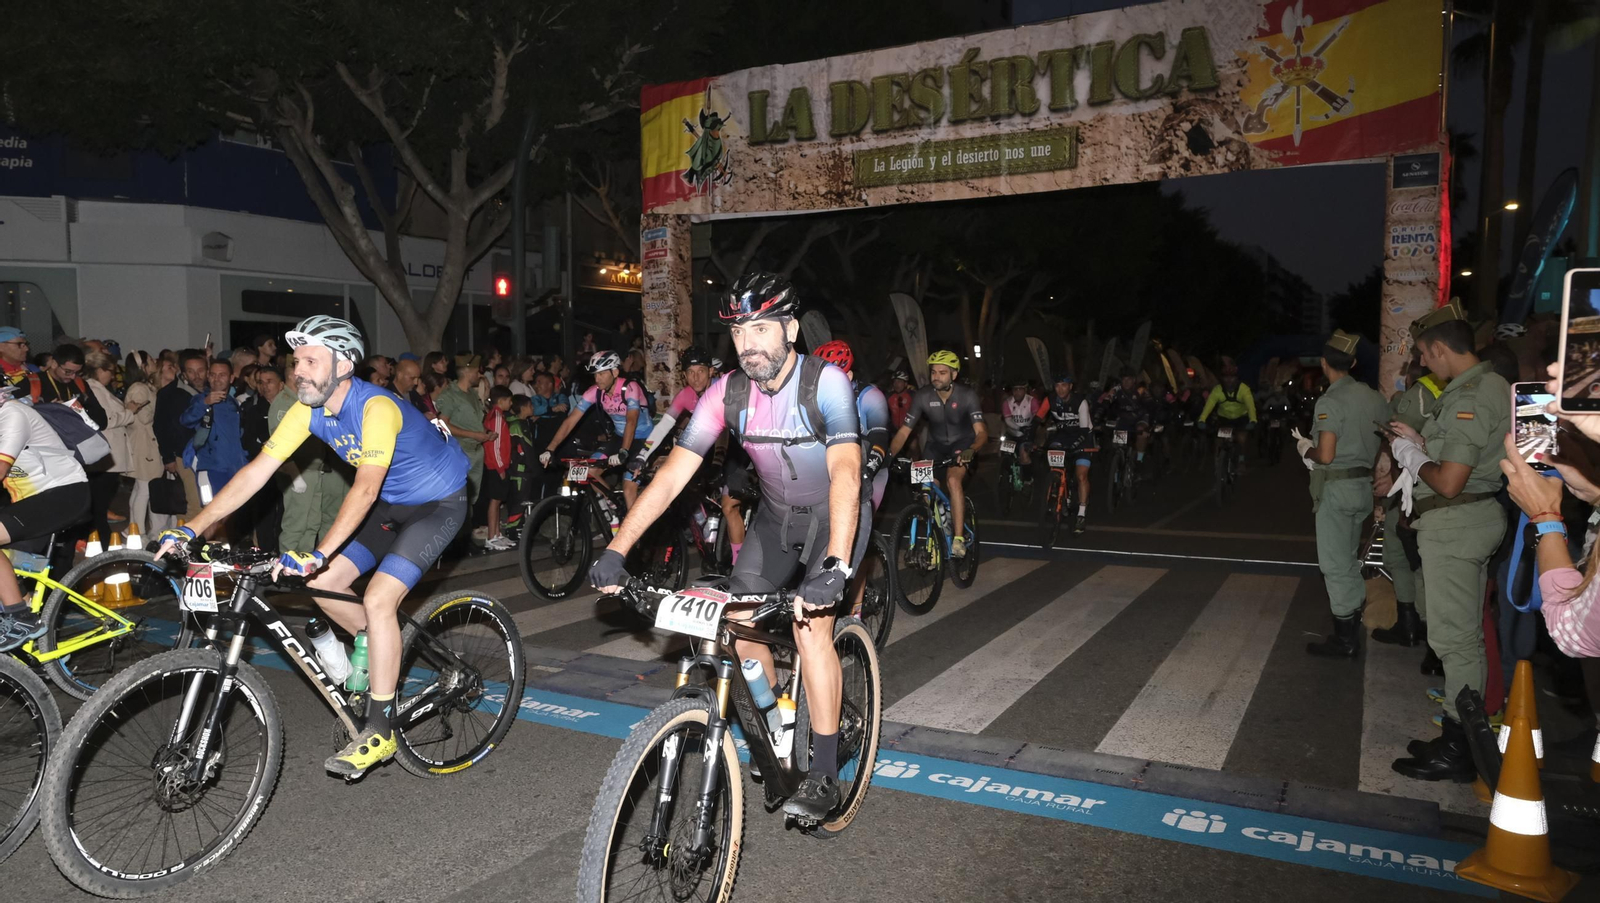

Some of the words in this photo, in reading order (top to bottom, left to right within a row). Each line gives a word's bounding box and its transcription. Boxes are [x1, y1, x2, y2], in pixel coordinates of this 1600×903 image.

[747, 86, 817, 145] LA
[828, 24, 1221, 138] DESÉRTICA
[873, 157, 886, 173] La
[889, 152, 925, 174] Legión
[929, 155, 938, 171] y
[941, 149, 952, 166] el
[956, 147, 1000, 165] desierto
[1004, 146, 1027, 161] nos
[1030, 143, 1052, 158] une
[1391, 232, 1435, 245] RENTA
[1392, 225, 1434, 233] GRUPO
[1391, 244, 1436, 257] TODO
[420, 516, 459, 567] KAIS
[670, 595, 718, 622] 7410
[266, 620, 347, 708] FOCUS
[928, 773, 1107, 810] cajamar
[1005, 795, 1041, 807] CAJA
[1045, 802, 1093, 816] RURAL
[1348, 855, 1396, 870] CAJA
